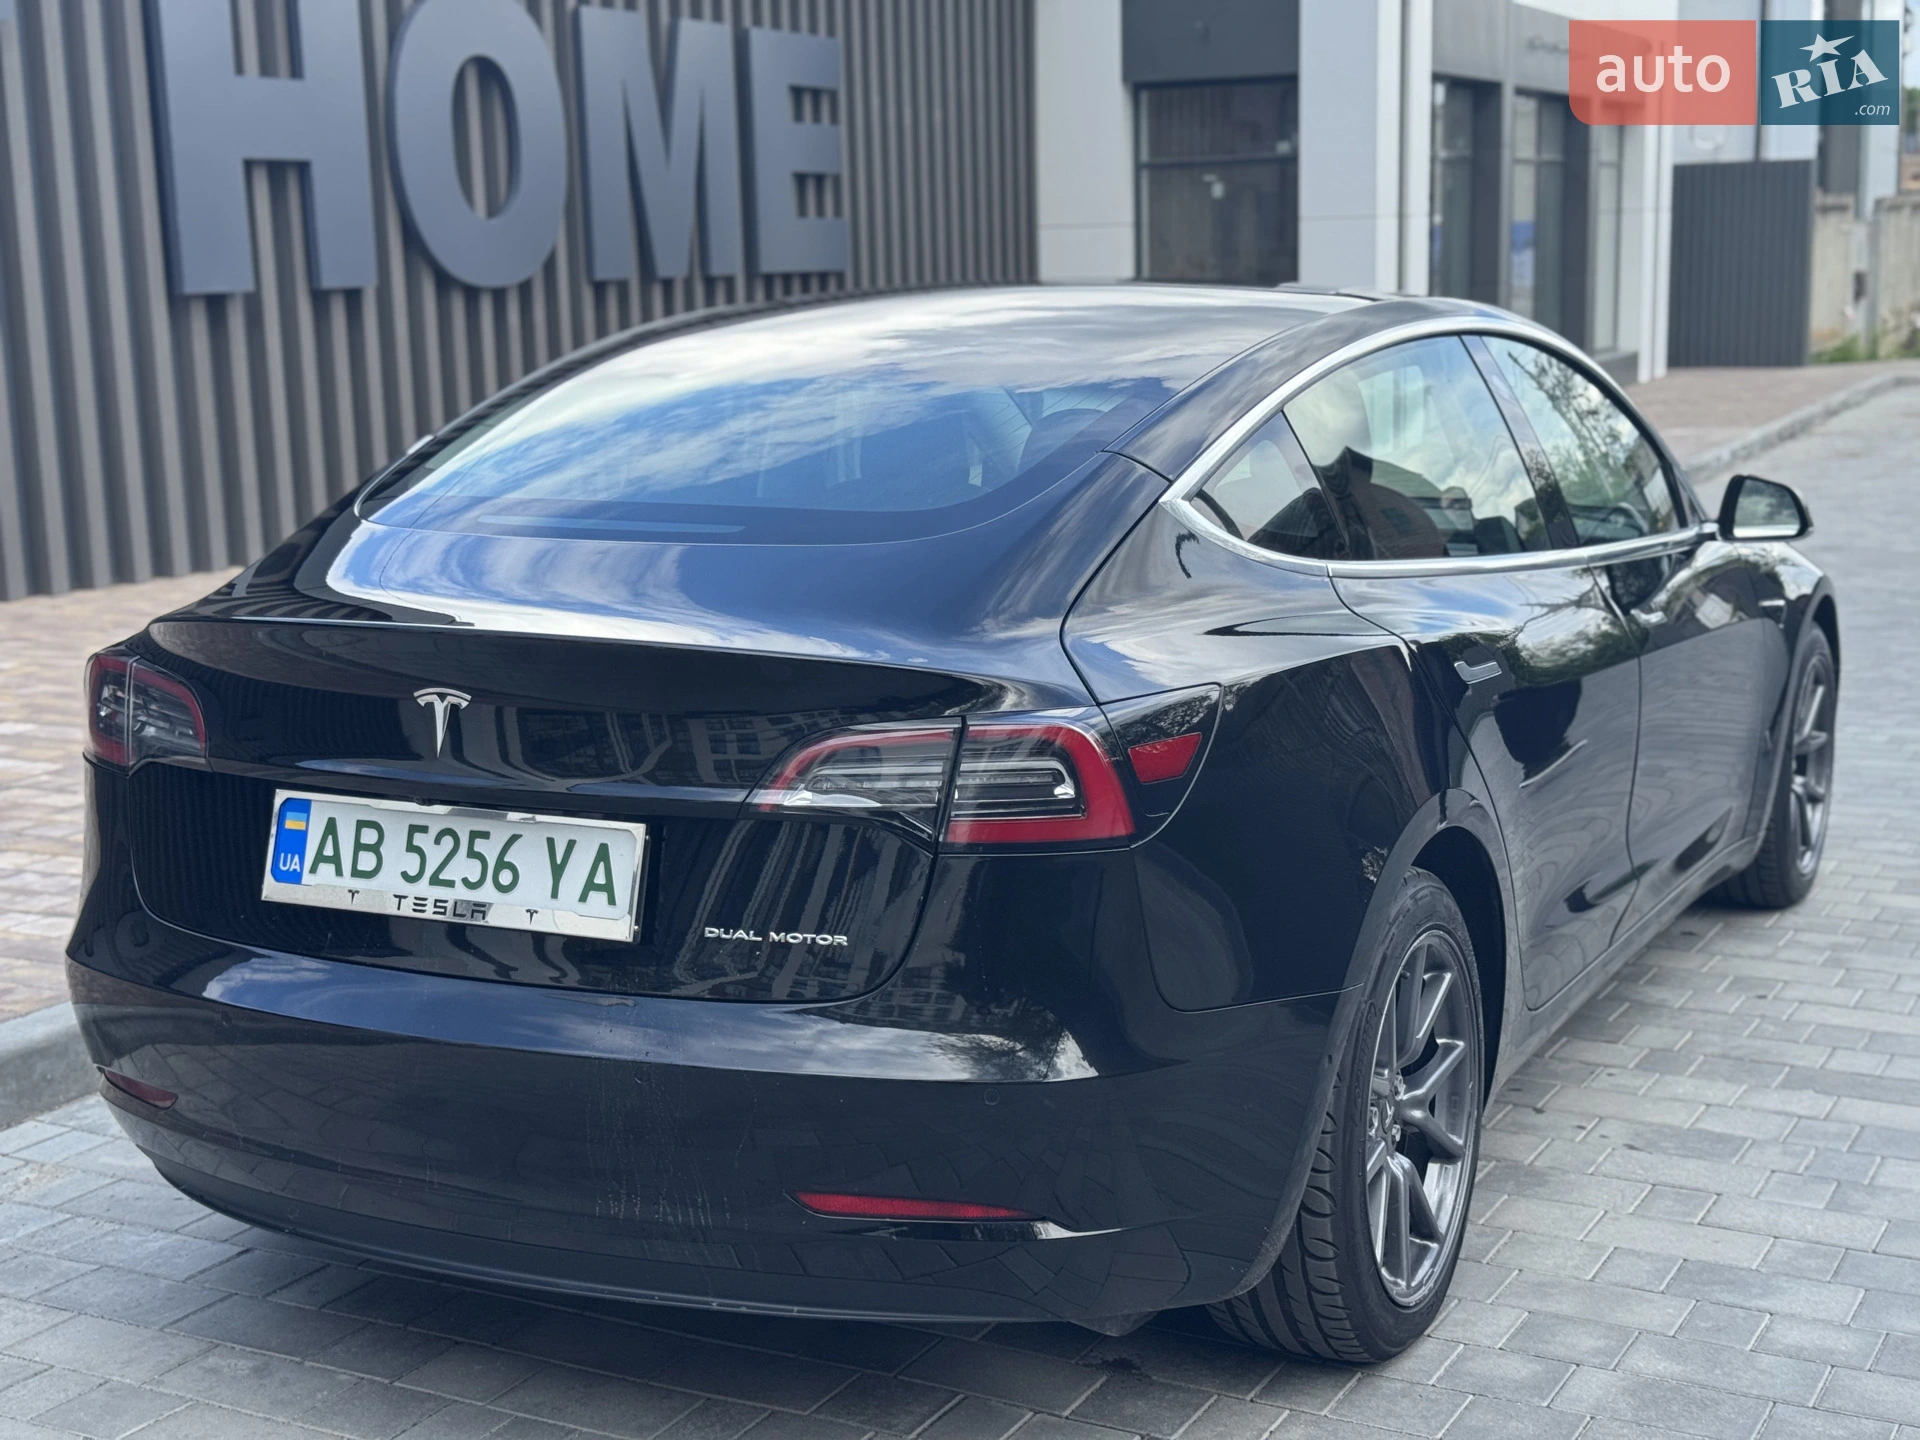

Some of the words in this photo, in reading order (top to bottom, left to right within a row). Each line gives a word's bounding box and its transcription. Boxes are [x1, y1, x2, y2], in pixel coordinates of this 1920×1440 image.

[152, 0, 850, 294] HOME
[279, 852, 301, 873] UA
[308, 816, 386, 879] AB
[400, 823, 524, 894] 5256
[546, 836, 618, 907] YA
[392, 893, 488, 921] TESLA
[704, 926, 763, 941] DUAL
[768, 931, 848, 946] MOTOR
